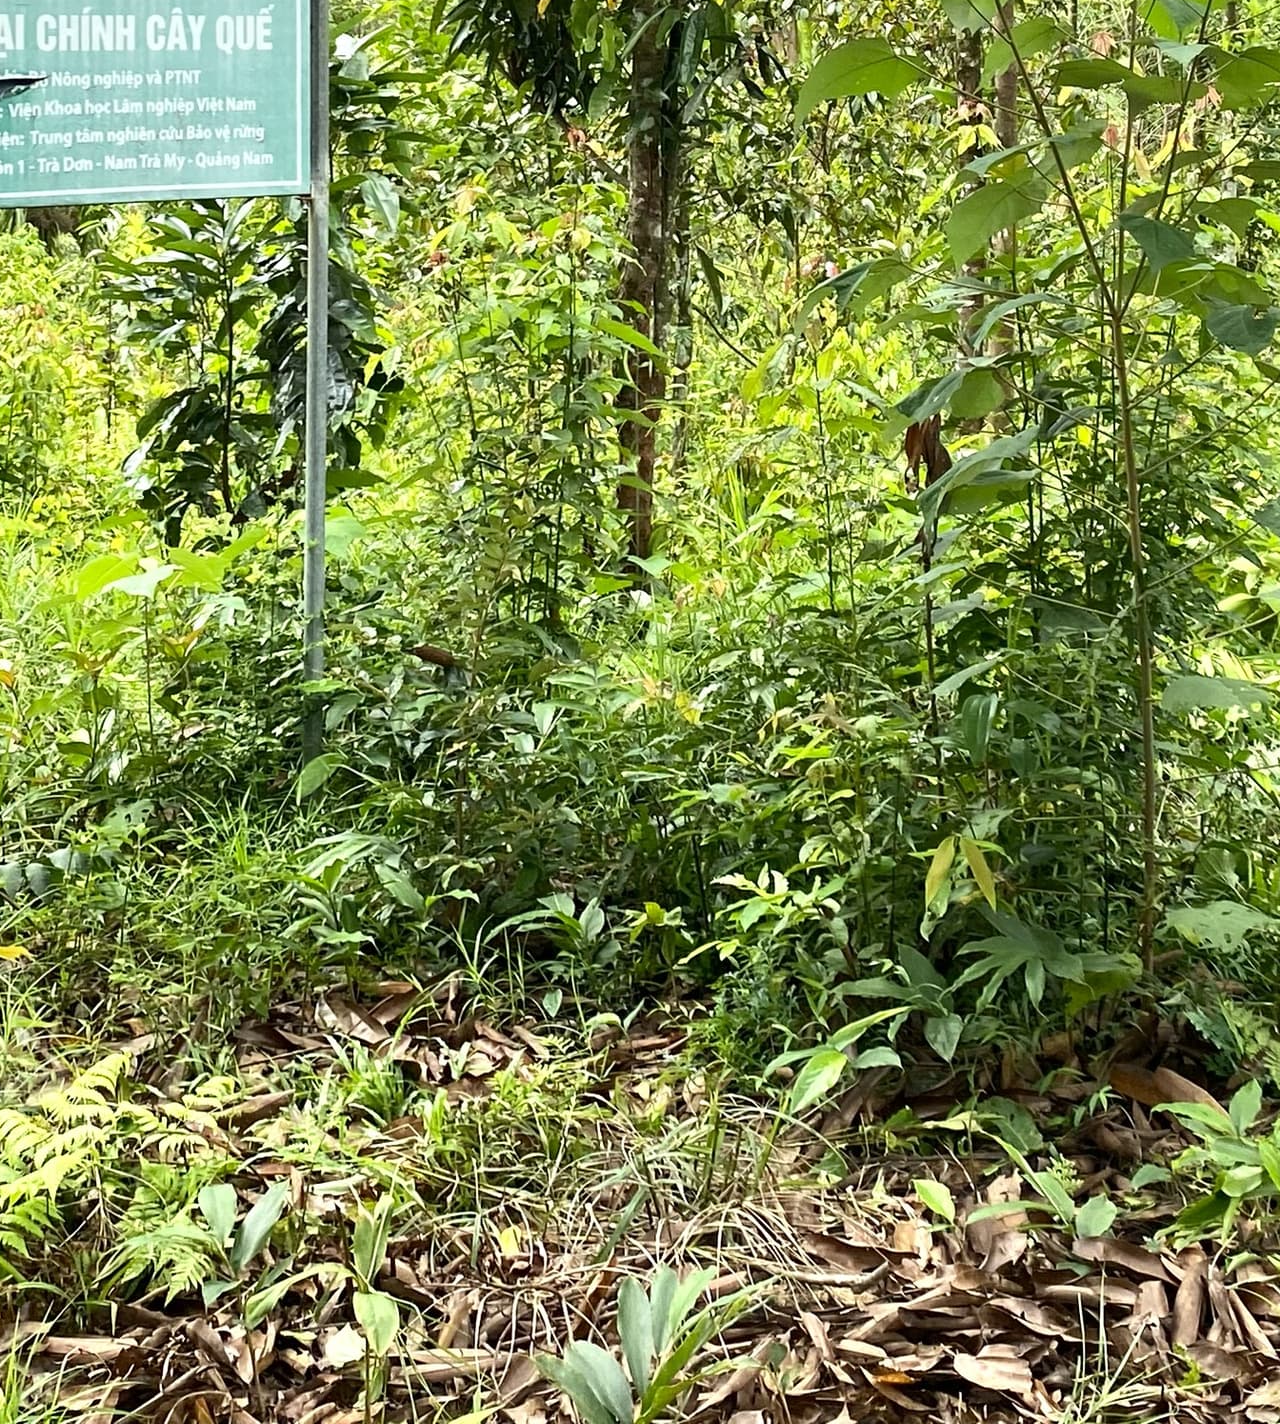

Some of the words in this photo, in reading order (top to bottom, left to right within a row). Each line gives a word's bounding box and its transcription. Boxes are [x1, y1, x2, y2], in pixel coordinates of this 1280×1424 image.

[36, 6, 135, 51] CHÍNH
[146, 8, 205, 51] CÂY
[216, 4, 274, 55] QUẾ
[52, 71, 90, 89] Nông
[94, 70, 143, 89] nghiệp
[146, 70, 162, 85] và
[165, 70, 201, 85] PTNT
[8, 100, 41, 120] Viện
[44, 100, 81, 116] Khoa
[85, 99, 110, 119] học
[113, 98, 143, 114] Lâm
[146, 98, 194, 116] nghiệp
[196, 97, 223, 115] Việt
[226, 97, 256, 112] Nam
[30, 130, 72, 147] Trung
[76, 128, 103, 143] tâm
[107, 126, 156, 145] nghiên
[186, 125, 212, 140] Bảo
[214, 124, 231, 141] vệ
[233, 123, 265, 142] rừng
[18, 161, 25, 174] 1
[37, 157, 60, 173] Trà
[104, 155, 137, 170] Nam
[140, 153, 160, 168] Trà
[164, 153, 185, 171] My
[196, 151, 240, 170] Quảng
[243, 151, 273, 165] Nam
